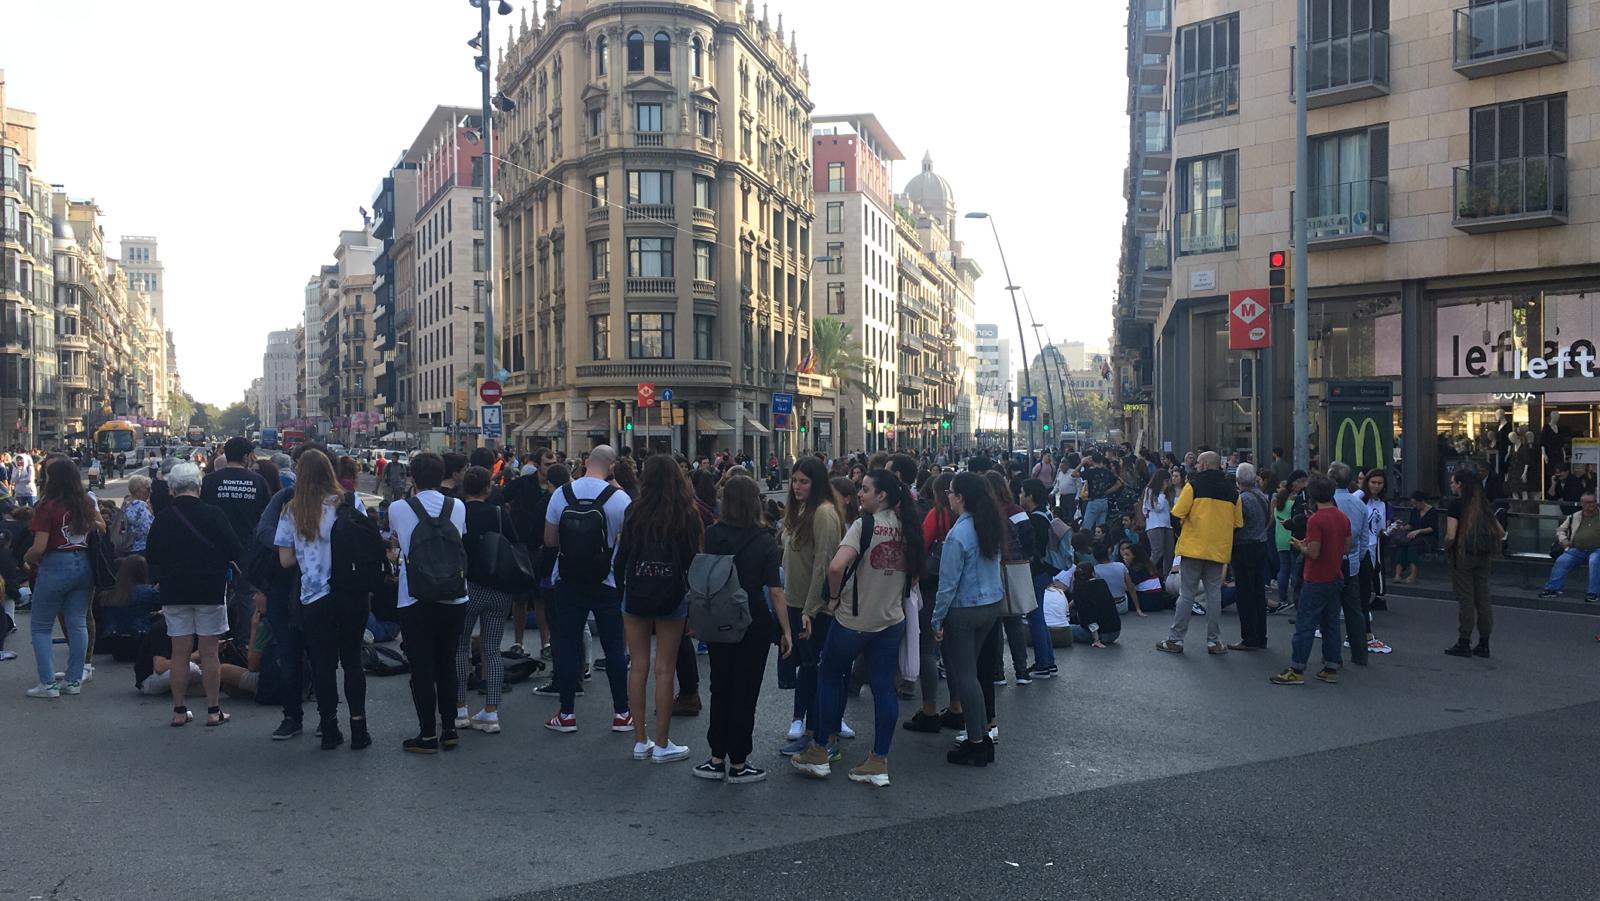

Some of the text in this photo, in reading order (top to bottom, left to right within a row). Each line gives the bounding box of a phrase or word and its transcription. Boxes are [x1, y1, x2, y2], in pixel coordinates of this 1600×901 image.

[1241, 304, 1255, 317] M
[1514, 347, 1594, 380] left
[1023, 398, 1034, 412] P
